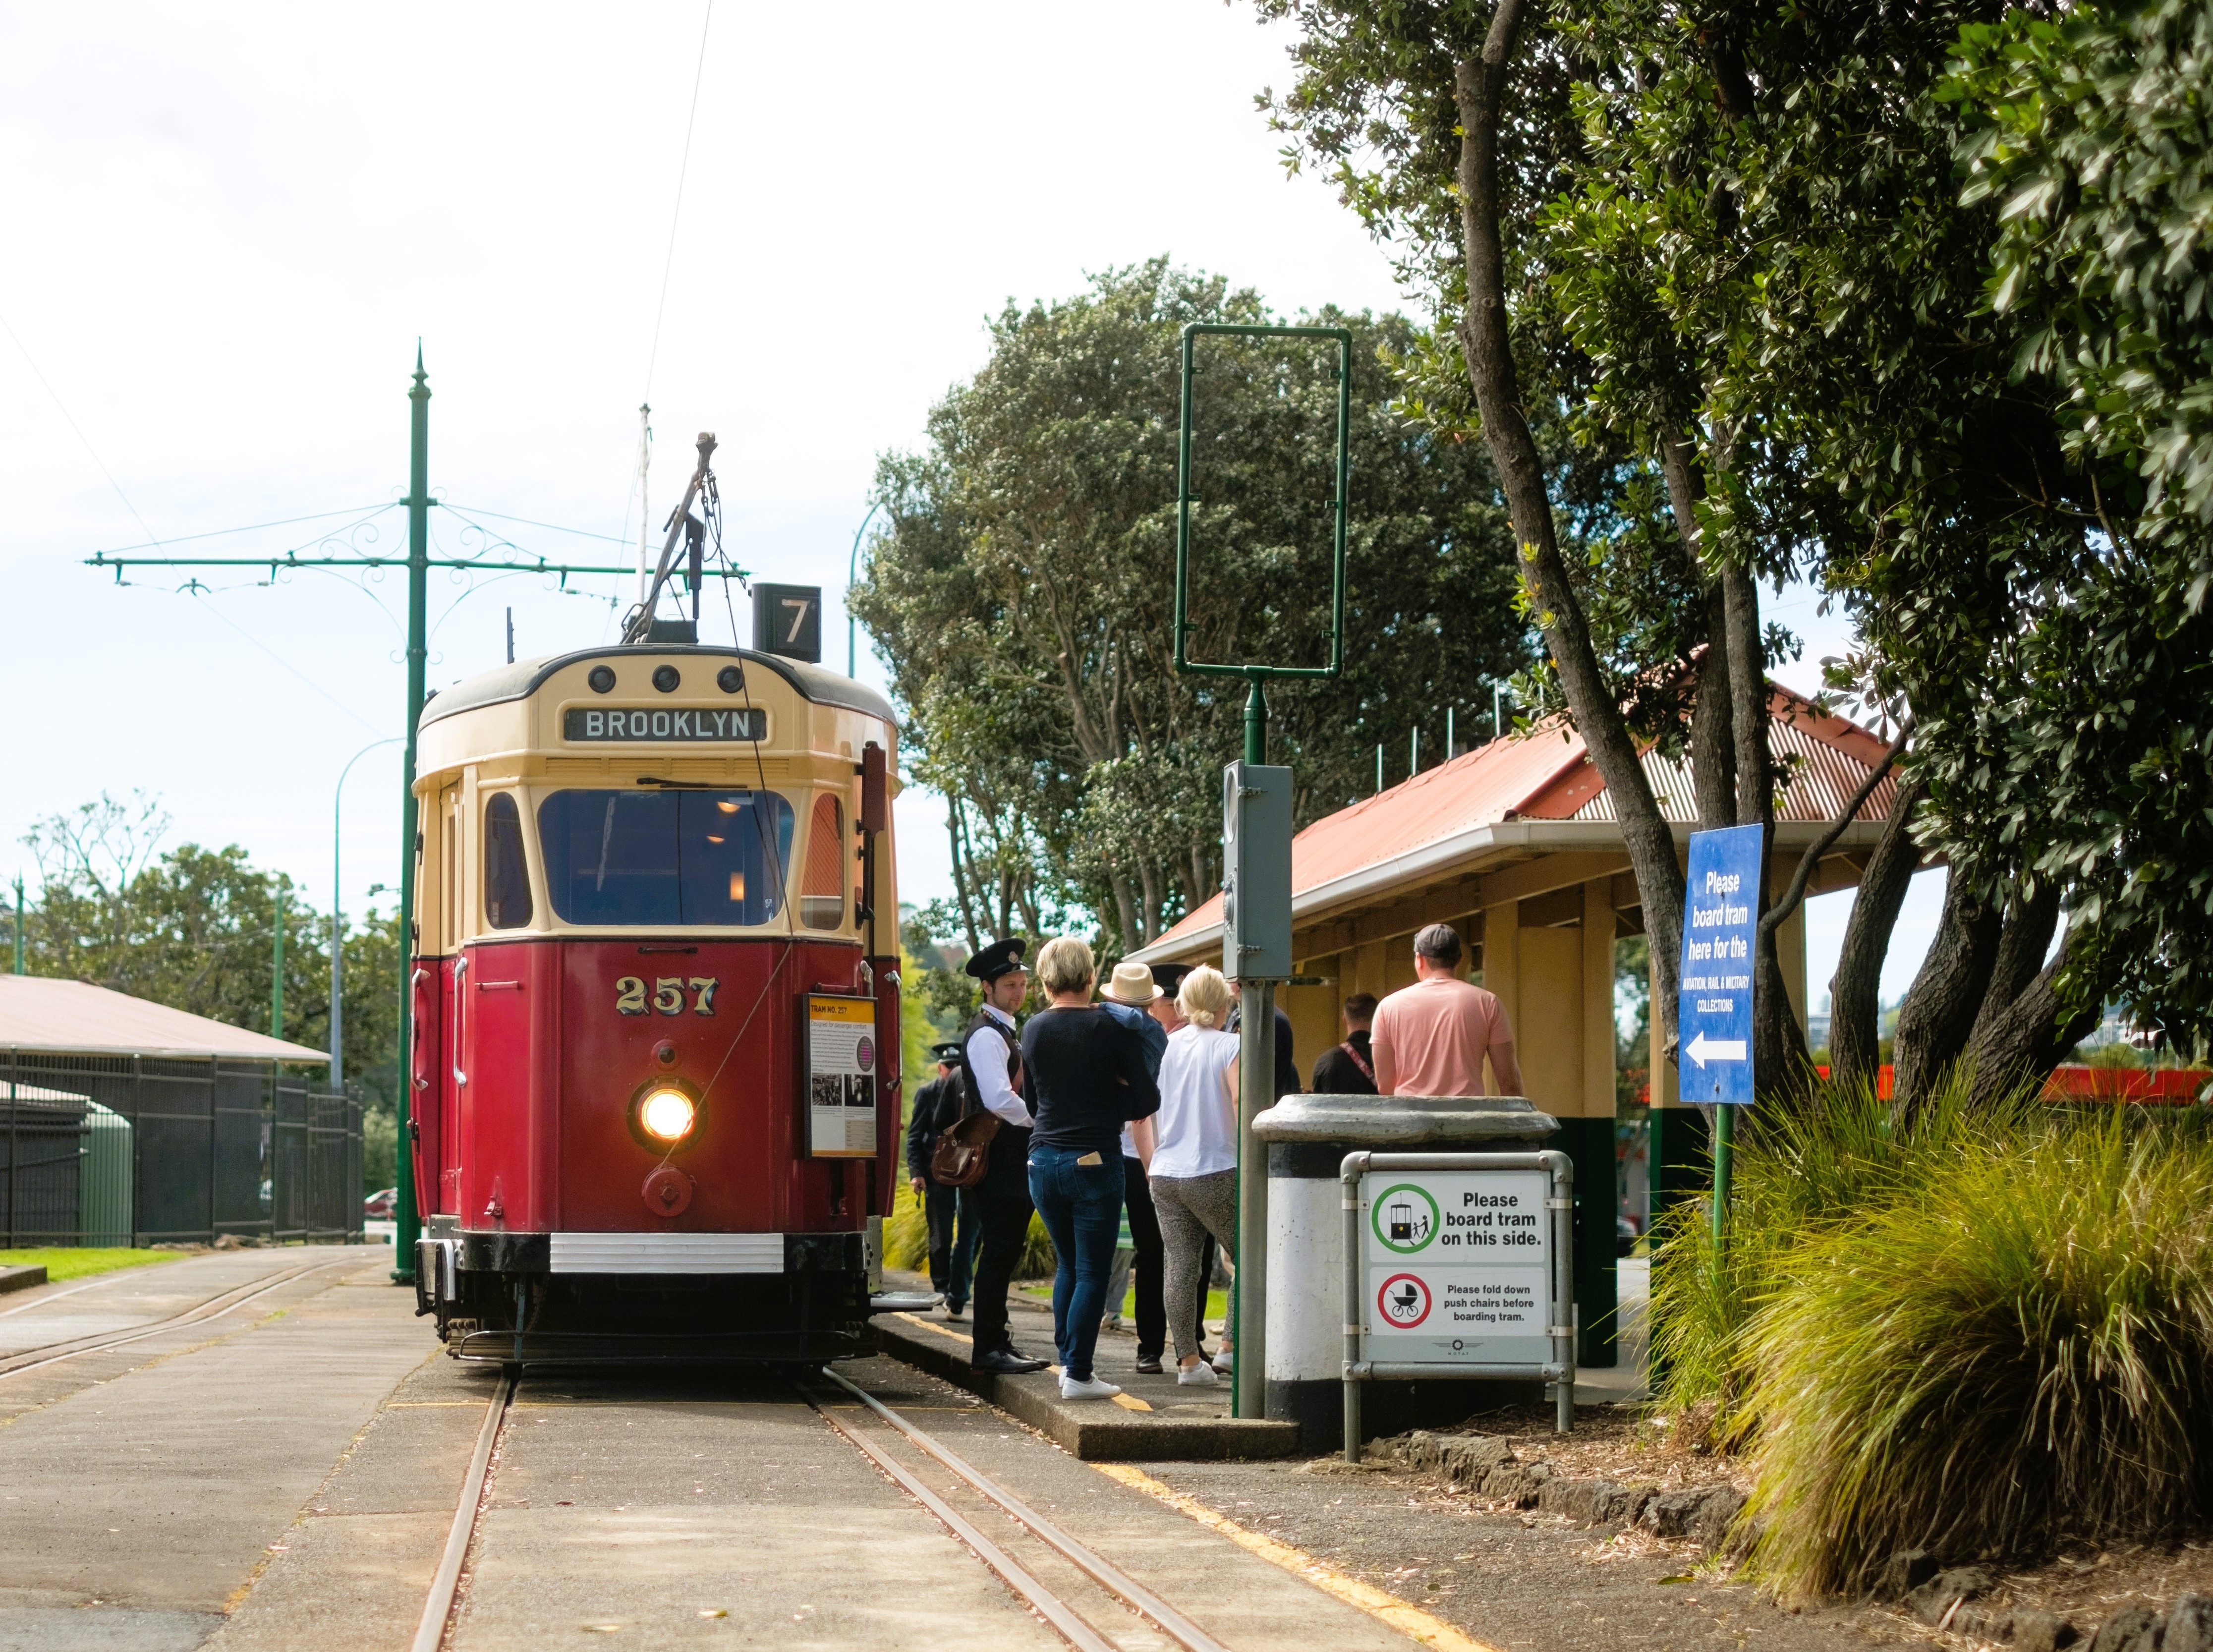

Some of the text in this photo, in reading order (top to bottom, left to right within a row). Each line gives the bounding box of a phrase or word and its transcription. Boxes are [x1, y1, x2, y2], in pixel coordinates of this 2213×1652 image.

[782, 599, 810, 643] 7
[586, 711, 749, 737] BROOKLYN
[1706, 871, 1740, 894] Please
[1692, 903, 1748, 928] board tram
[1688, 935, 1747, 960] here for the
[1682, 975, 1750, 992] AVIATION, RAIL & MILITARY
[616, 976, 719, 1016] 257
[811, 1004, 826, 1013] TRAM
[1697, 998, 1733, 1012] COLLECTIONS
[1464, 1192, 1518, 1207] Please
[1446, 1212, 1536, 1226] board tram
[1441, 1230, 1541, 1245] on this side.
[1448, 1285, 1530, 1294] Please fold down
[1444, 1298, 1534, 1309] push chairs before
[1454, 1312, 1524, 1322] boarding tram.
